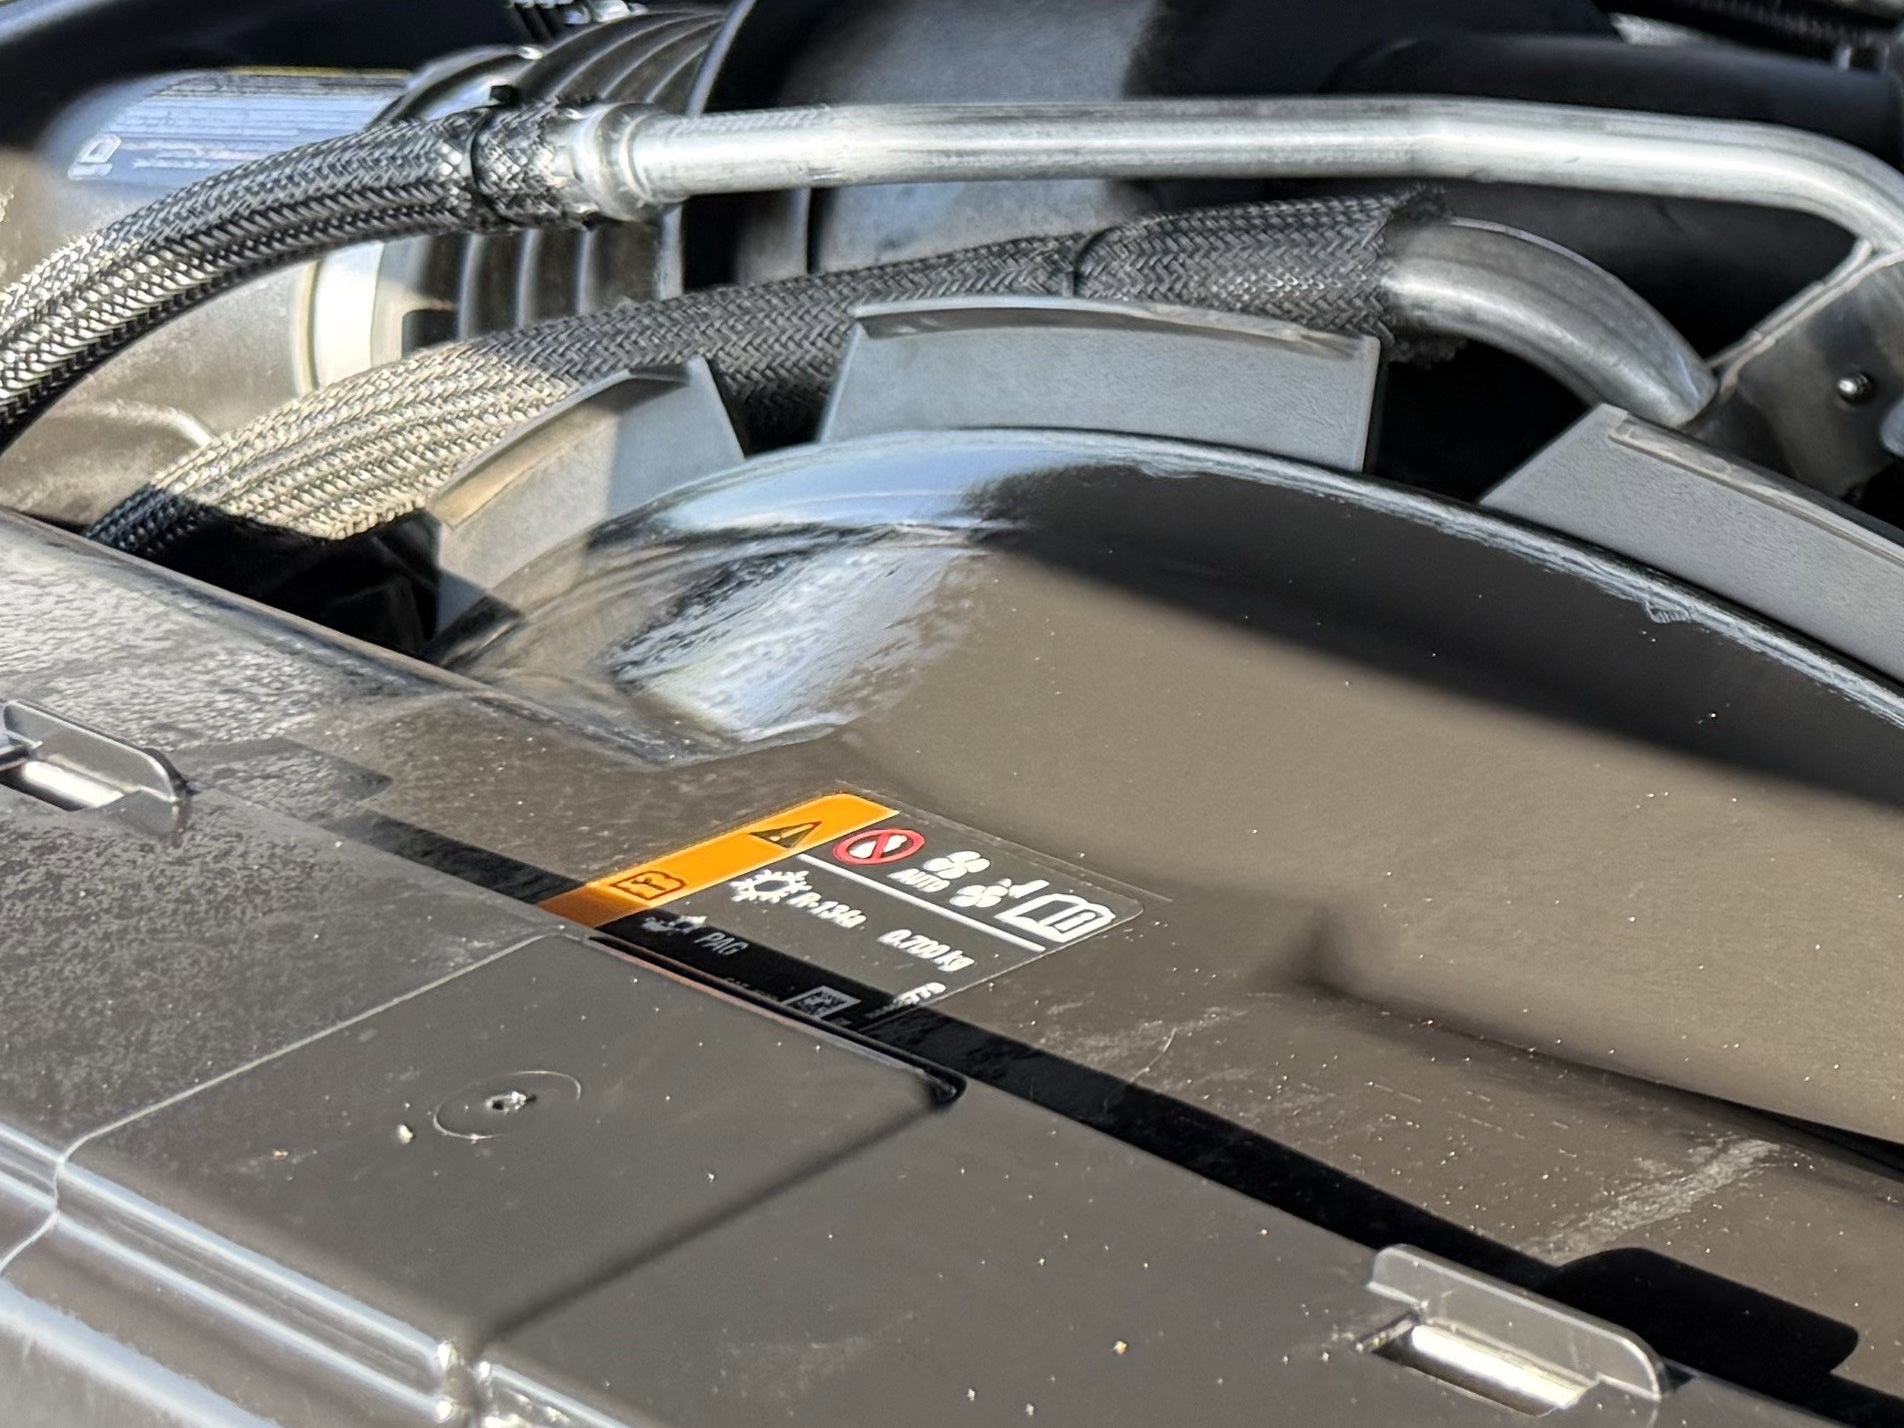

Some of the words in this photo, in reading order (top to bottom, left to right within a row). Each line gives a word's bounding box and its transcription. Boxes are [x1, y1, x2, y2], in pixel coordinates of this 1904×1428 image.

[886, 868, 950, 893] AUTO
[785, 891, 867, 929] R-134a
[693, 931, 749, 956] PAG
